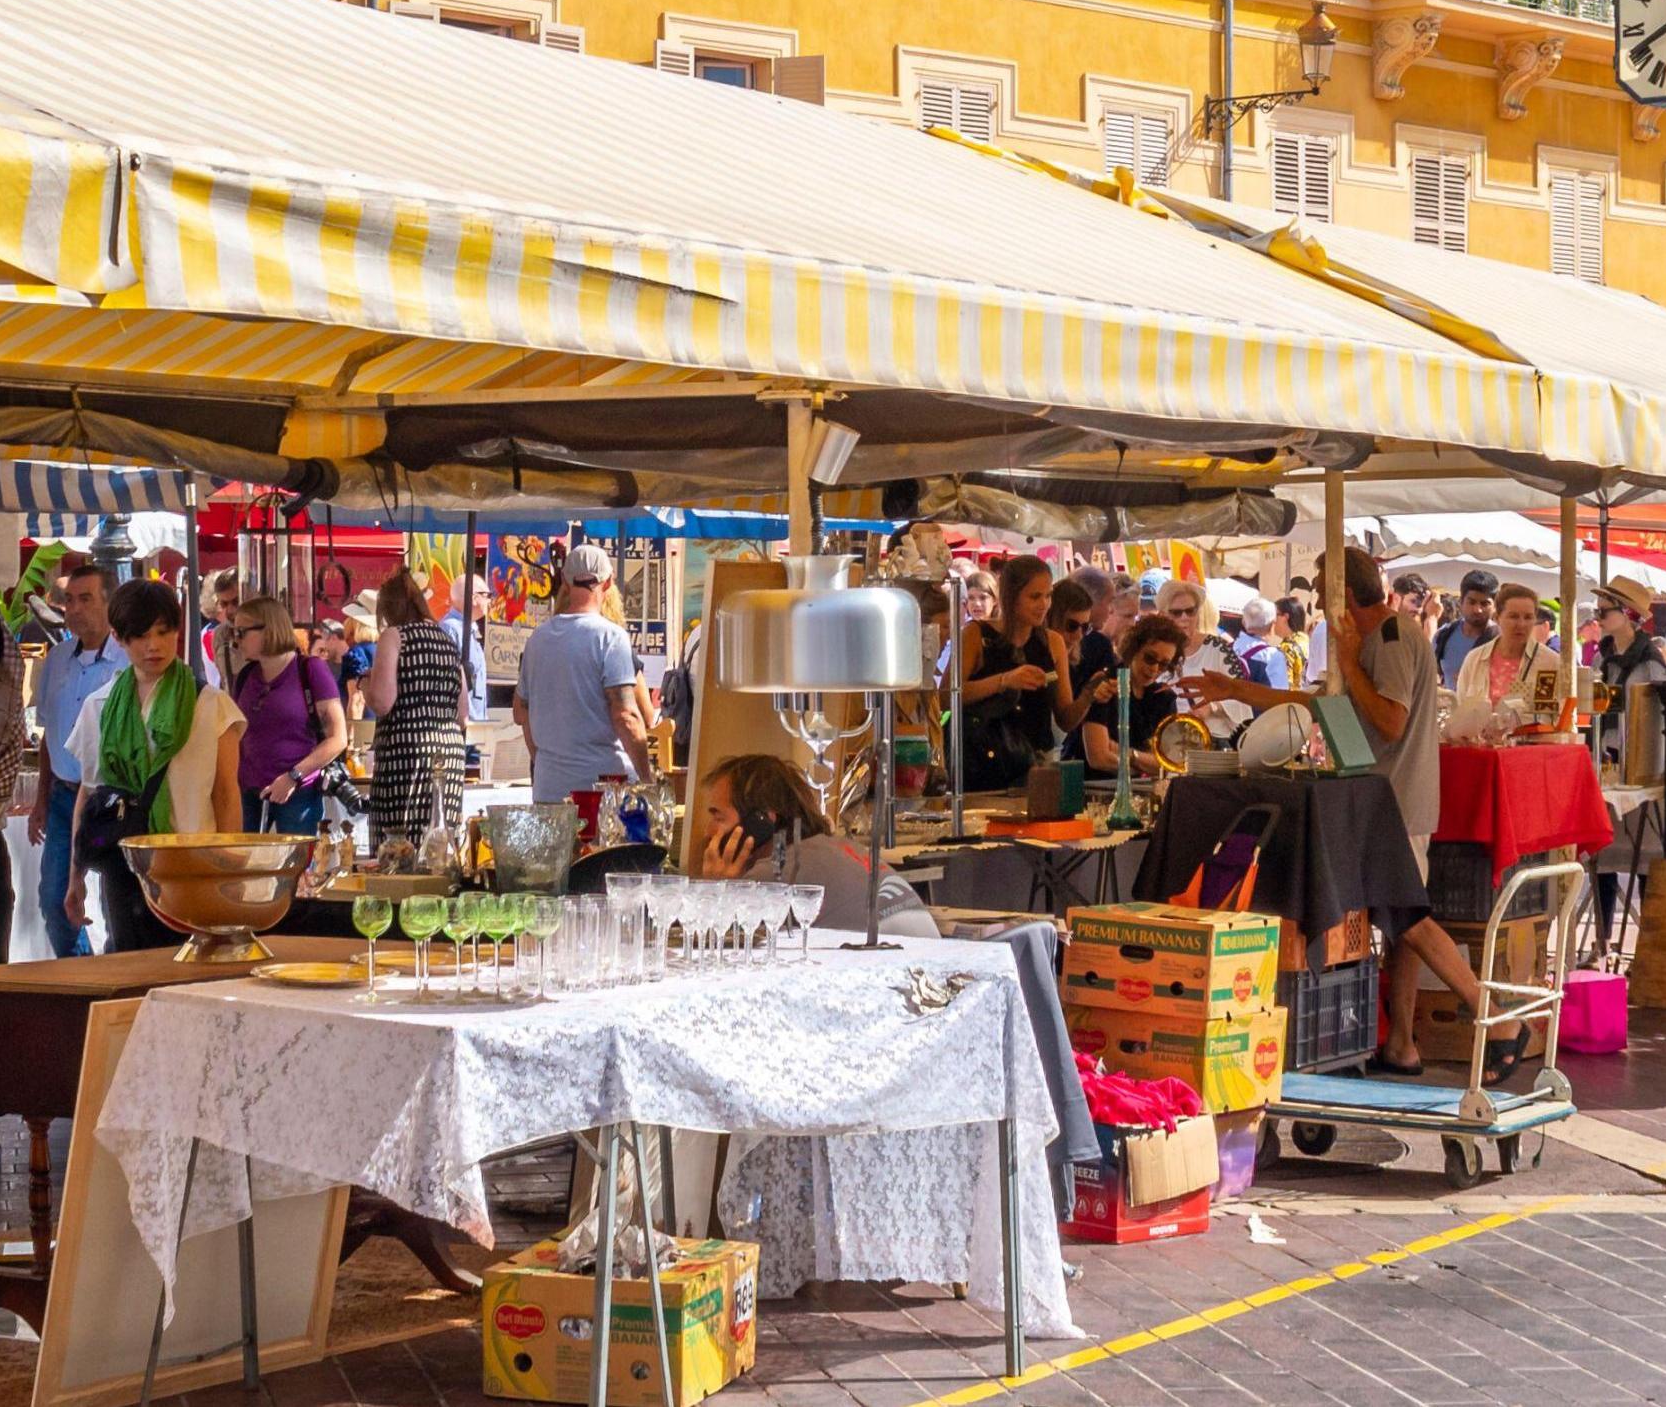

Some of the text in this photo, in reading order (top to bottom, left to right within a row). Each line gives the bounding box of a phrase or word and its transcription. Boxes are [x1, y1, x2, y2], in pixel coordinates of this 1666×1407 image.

[492, 646, 518, 665] CARN
[1076, 922, 1202, 950] PREMIUM BANANAS
[1073, 1167, 1100, 1181] REEZE
[611, 1332, 677, 1347] BANANS
